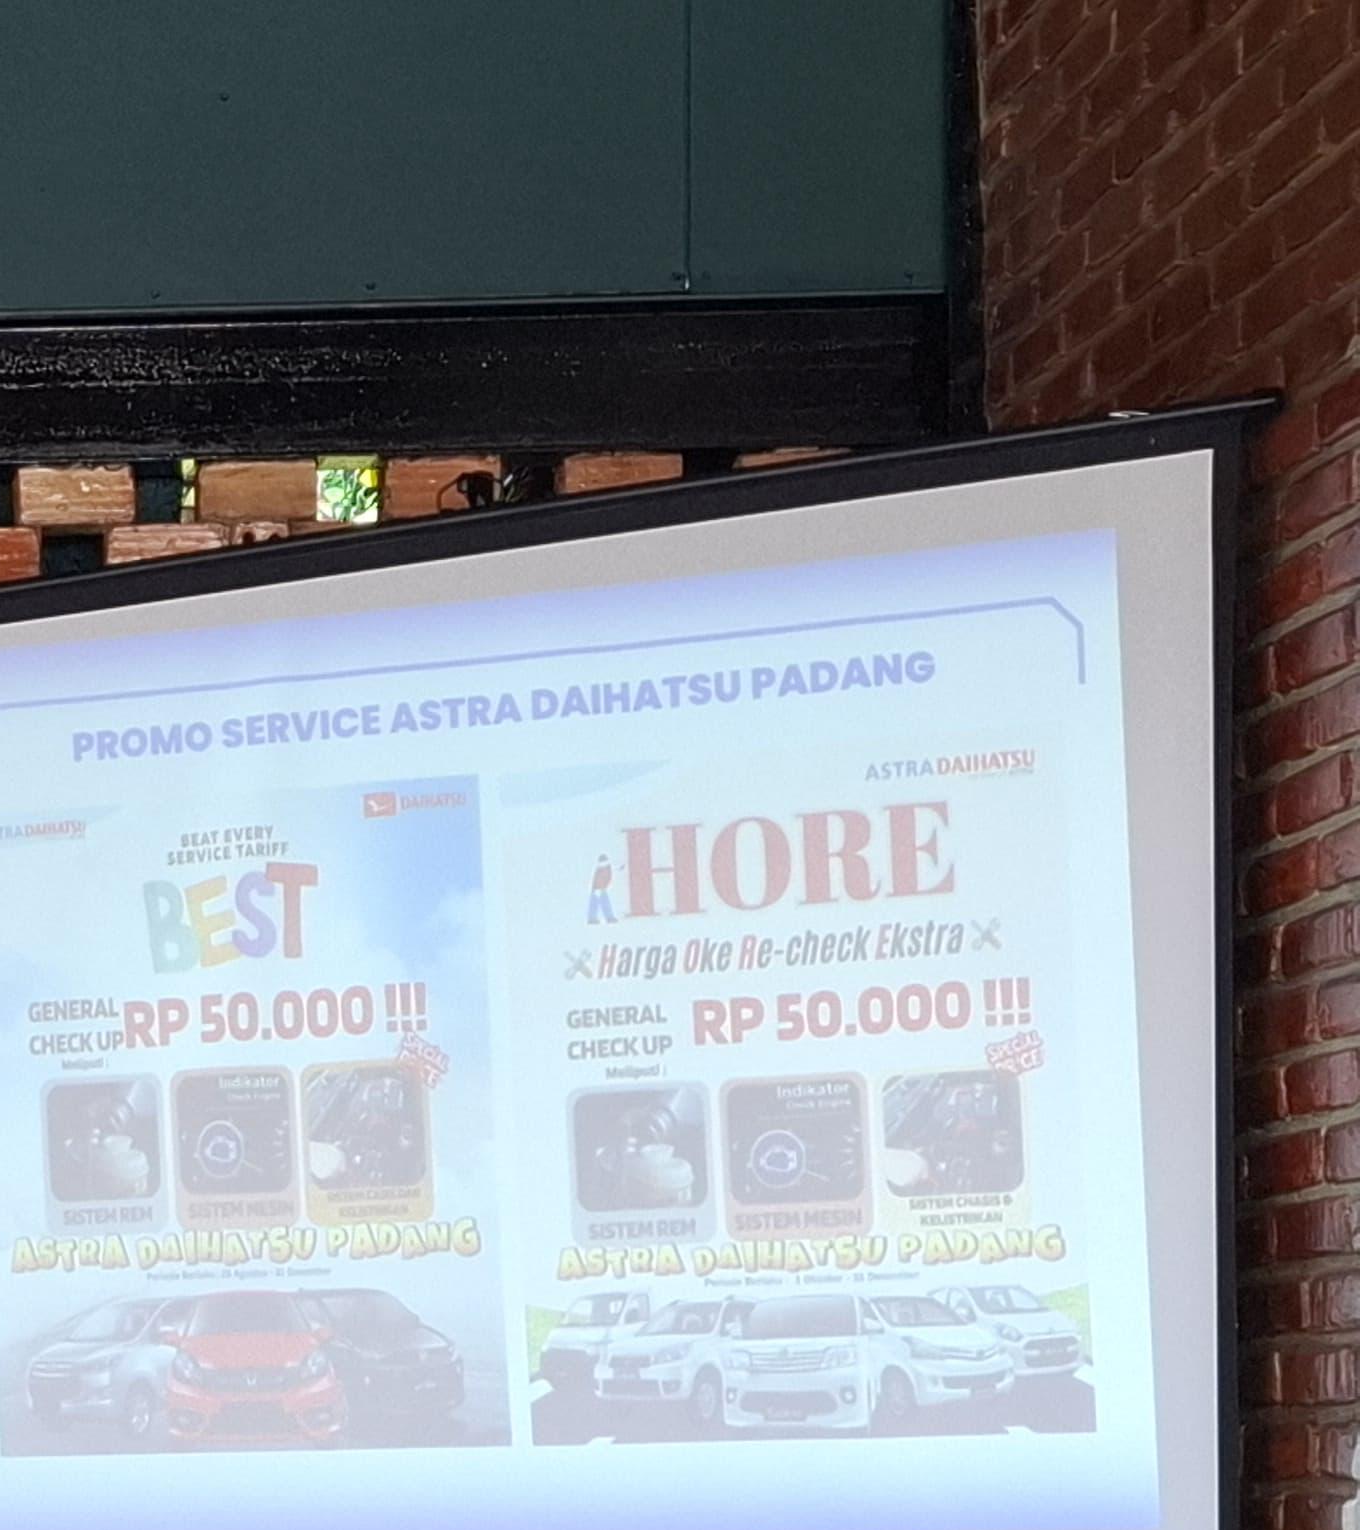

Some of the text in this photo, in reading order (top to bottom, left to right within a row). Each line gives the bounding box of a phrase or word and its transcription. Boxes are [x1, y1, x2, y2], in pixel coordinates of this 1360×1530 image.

[72, 650, 936, 763] PROMO SERVICE ASTRA DAIHATSU PADANG
[180, 824, 274, 848] BEAT EVERY
[166, 840, 289, 866] SERVICE TARIFF
[620, 799, 957, 920] HORE
[143, 861, 320, 975] BEST
[597, 920, 965, 980] Harga Oke Re-check Ekstra
[28, 997, 119, 1023] GENERAL
[123, 997, 190, 1049] RP
[200, 985, 375, 1044] 50.000
[566, 1003, 668, 1031] GENERAL
[692, 997, 765, 1047] RP
[776, 979, 972, 1042] 50.000
[29, 1030, 124, 1056] CHECK UP
[566, 1035, 673, 1061] CHECK UP
[62, 1207, 117, 1227] SISTEM
[589, 1218, 697, 1241] SISTEM REM
[734, 1208, 863, 1232] SISTEM MESIN
[11, 1215, 483, 1274] ASTRA DAIHATSU PADANG
[556, 1224, 1068, 1282] ASTRA DAIHATSU PADANG
